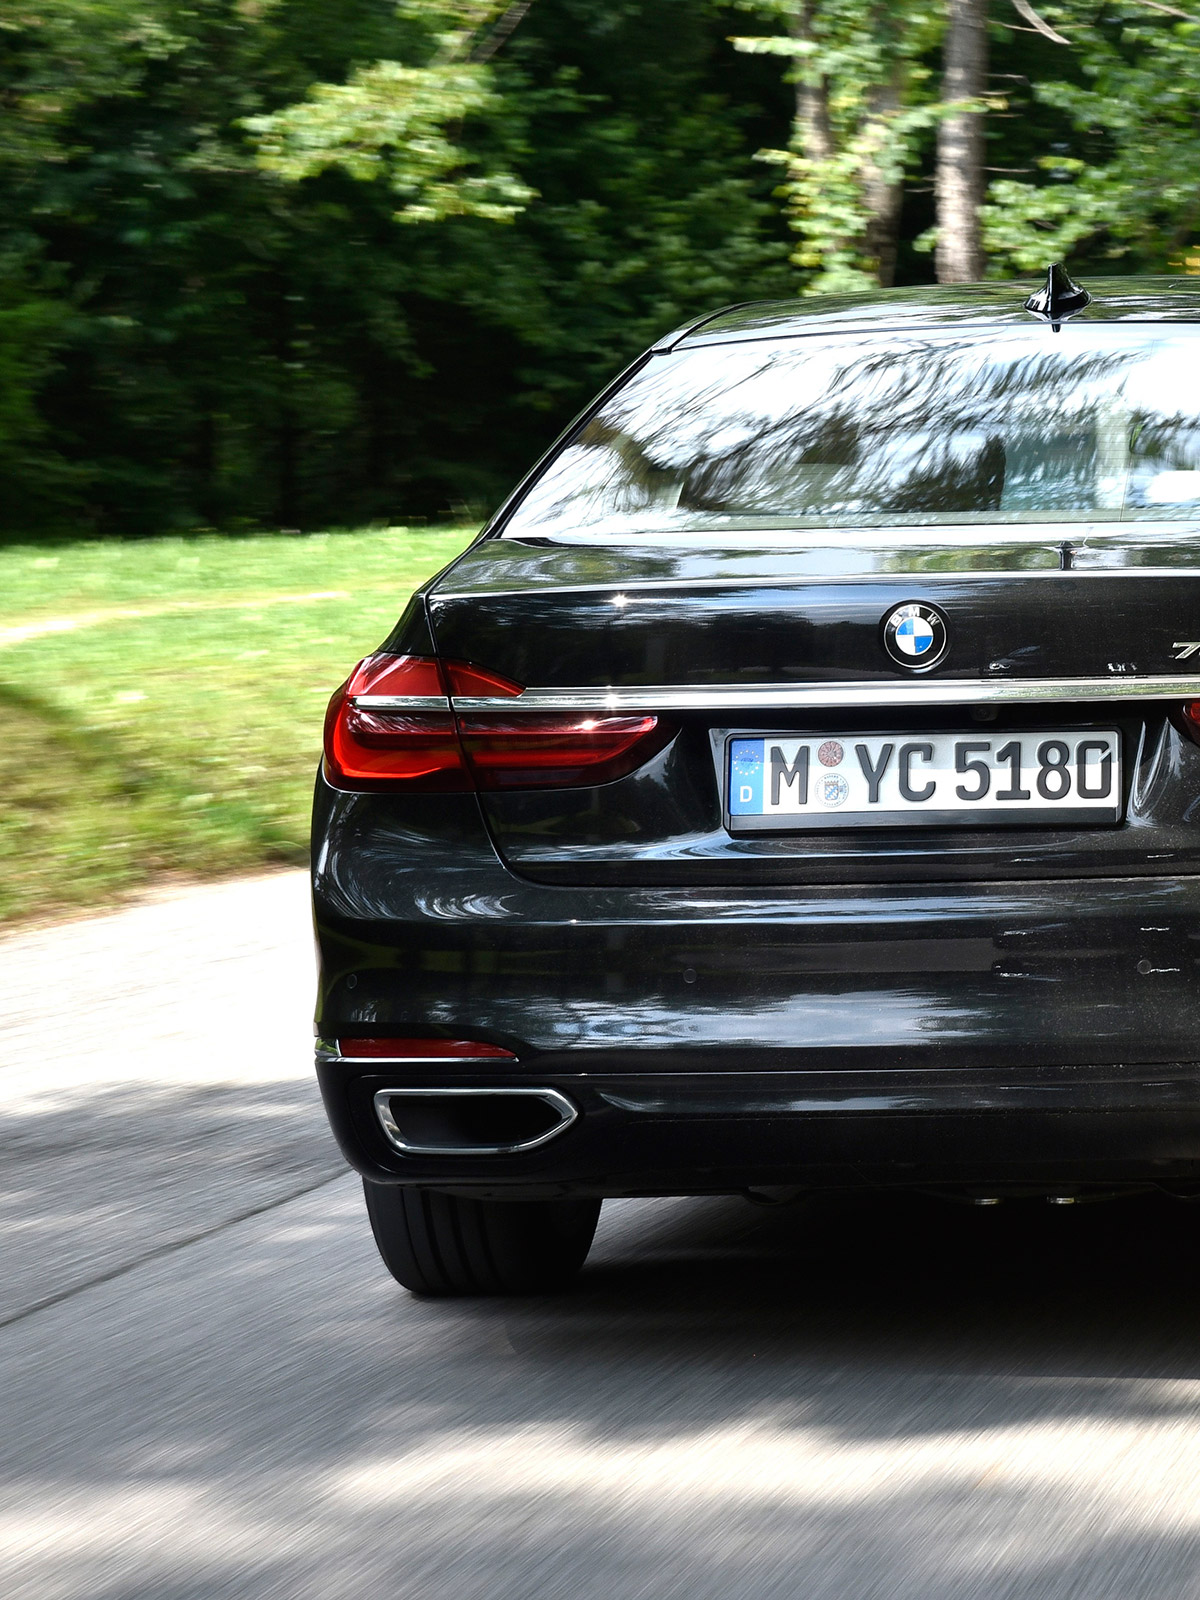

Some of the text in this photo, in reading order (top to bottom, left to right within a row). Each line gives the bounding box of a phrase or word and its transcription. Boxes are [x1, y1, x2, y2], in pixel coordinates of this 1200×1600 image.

[889, 606, 940, 628] BMW
[770, 745, 808, 805] M
[855, 742, 936, 803] YC
[955, 740, 1112, 800] 5180
[739, 785, 753, 803] D
